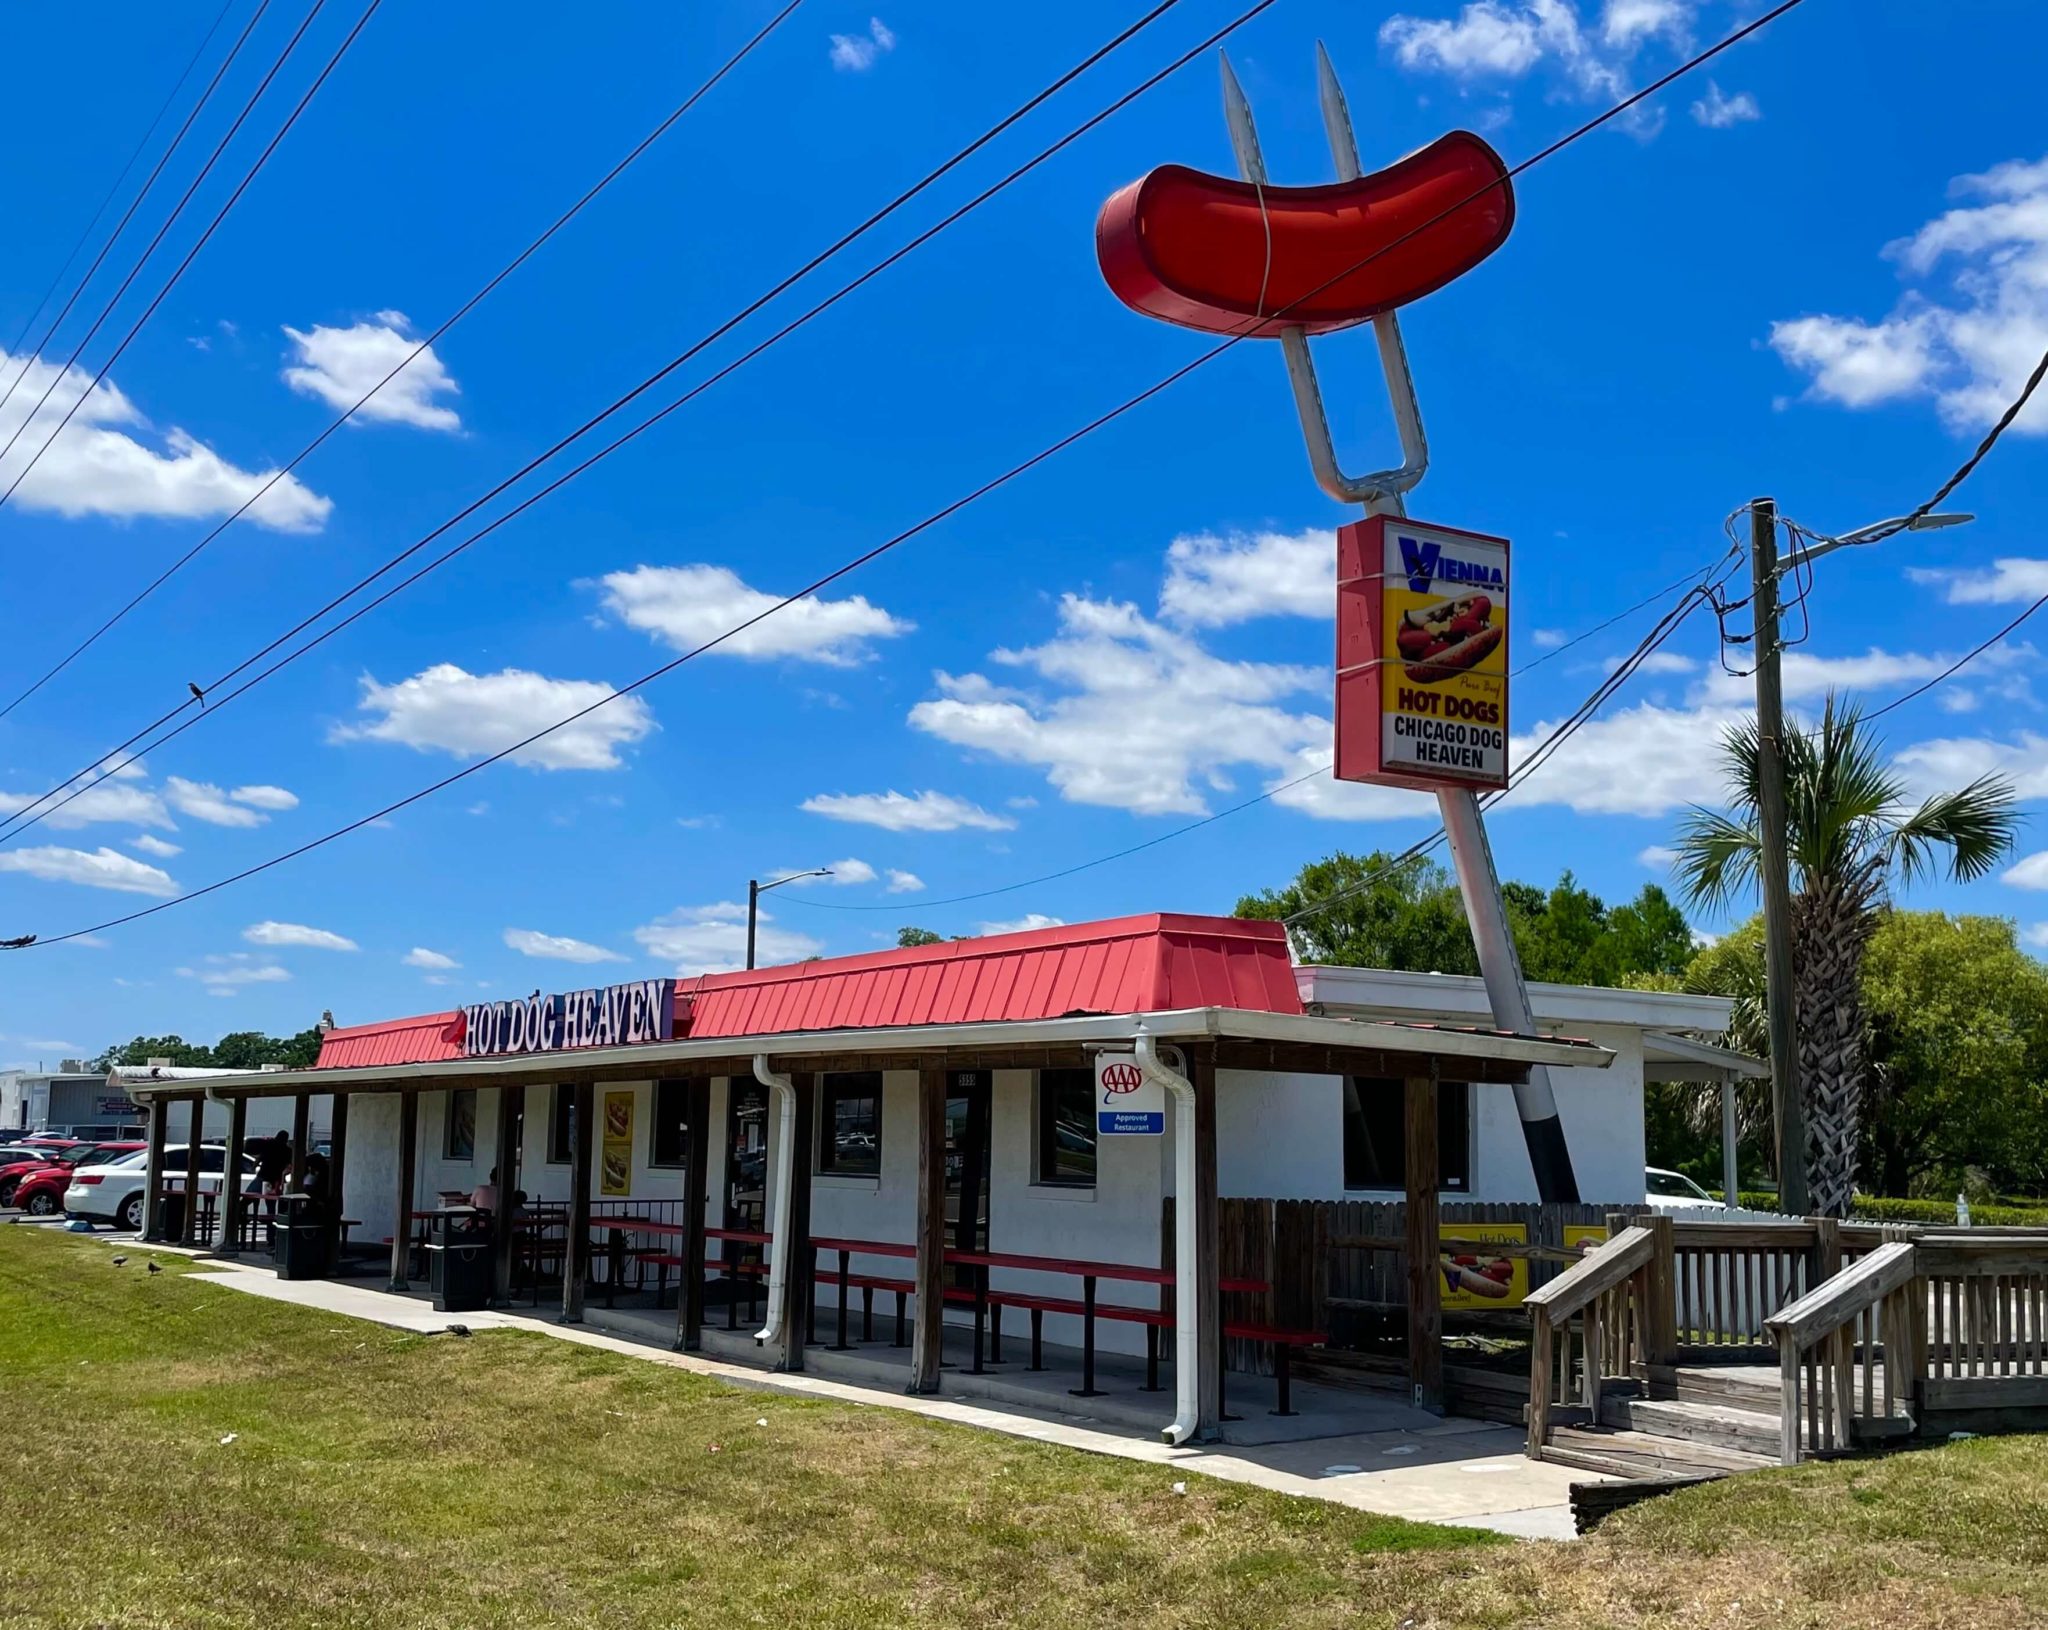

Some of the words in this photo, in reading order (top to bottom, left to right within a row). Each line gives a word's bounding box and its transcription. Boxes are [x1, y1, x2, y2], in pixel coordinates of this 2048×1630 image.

[1398, 536, 1505, 593] VIENNA
[1398, 687, 1441, 715] HOT
[1445, 694, 1499, 724] DOGS
[1394, 716, 1466, 744] CHICAGO
[1470, 727, 1502, 750] DOG
[1416, 741, 1483, 769] HEAVEN
[464, 1001, 507, 1055] HOT
[506, 994, 556, 1052] DOG
[562, 978, 666, 1048] HEAVEN
[1104, 1064, 1140, 1093] AAA
[1115, 1114, 1148, 1122] Approved
